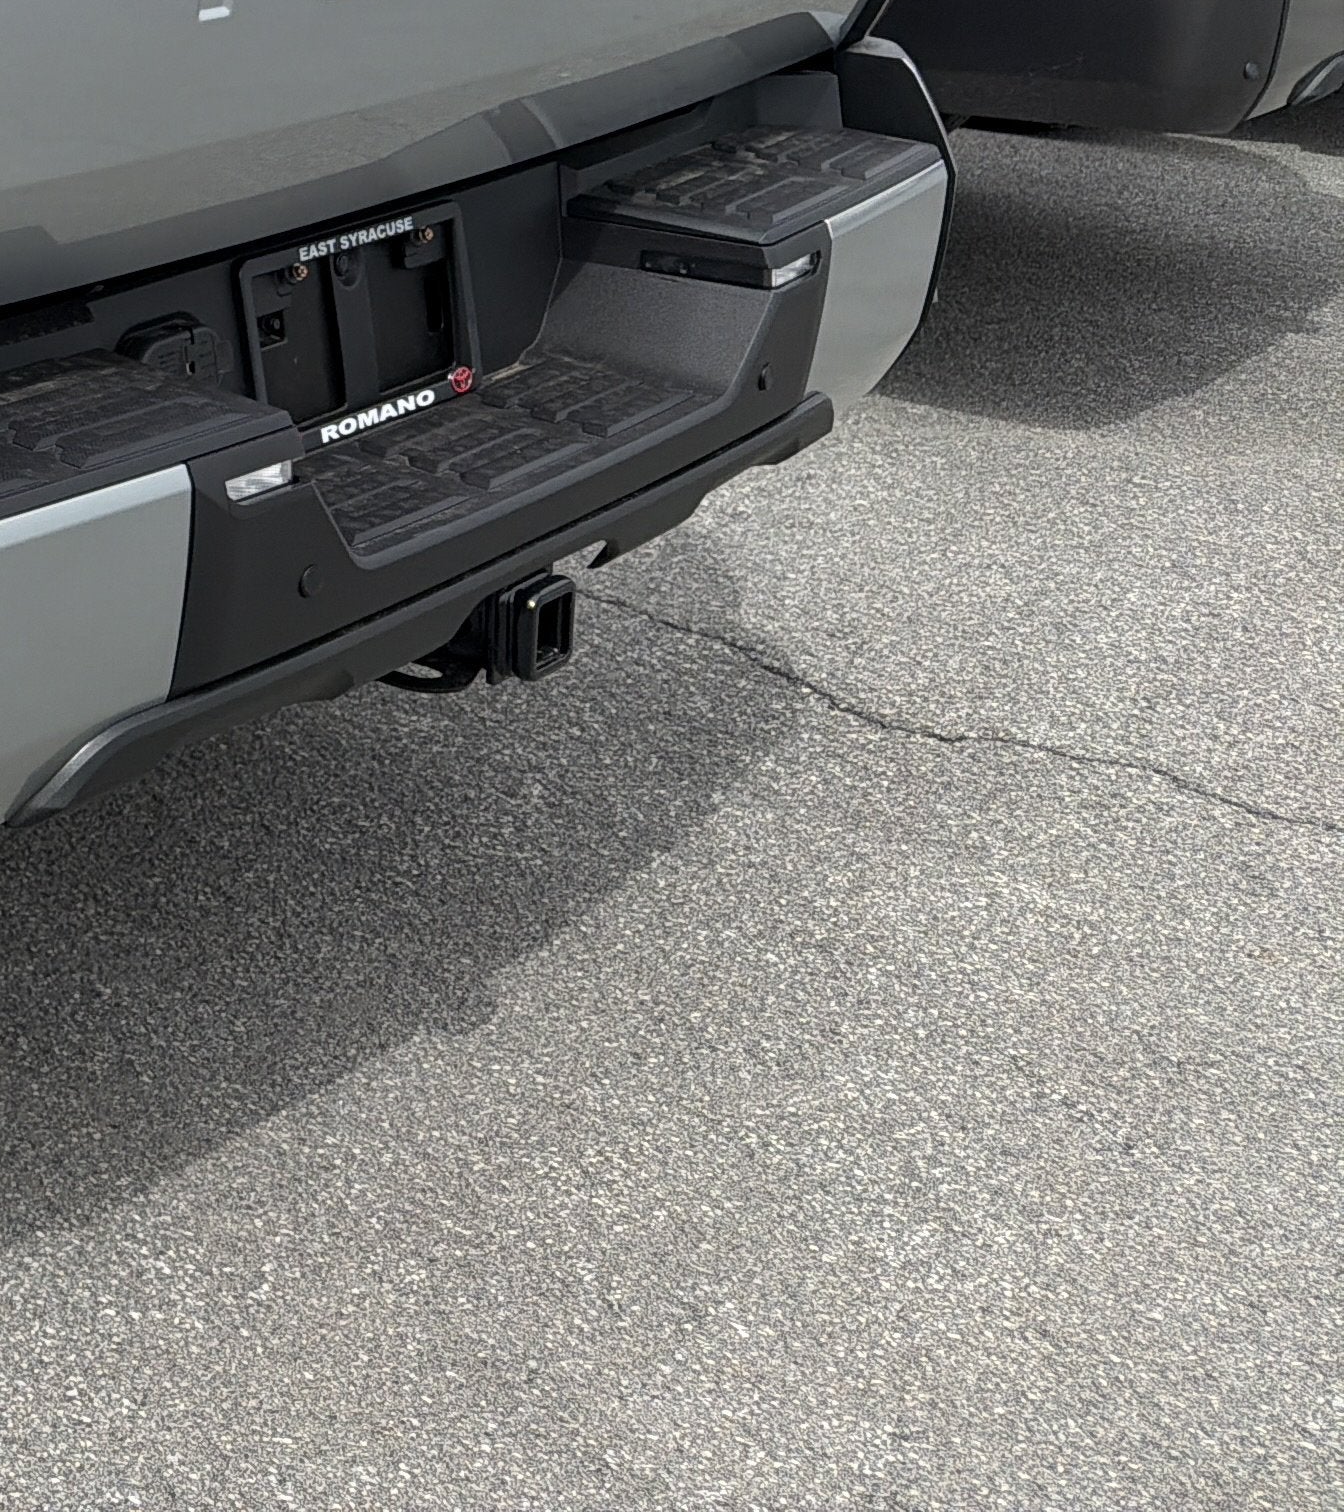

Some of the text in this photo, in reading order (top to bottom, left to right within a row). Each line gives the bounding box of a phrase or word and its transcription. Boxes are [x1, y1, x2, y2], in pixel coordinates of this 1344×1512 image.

[298, 216, 414, 262] EAST SYRACUSE
[321, 389, 435, 444] ROMANO
